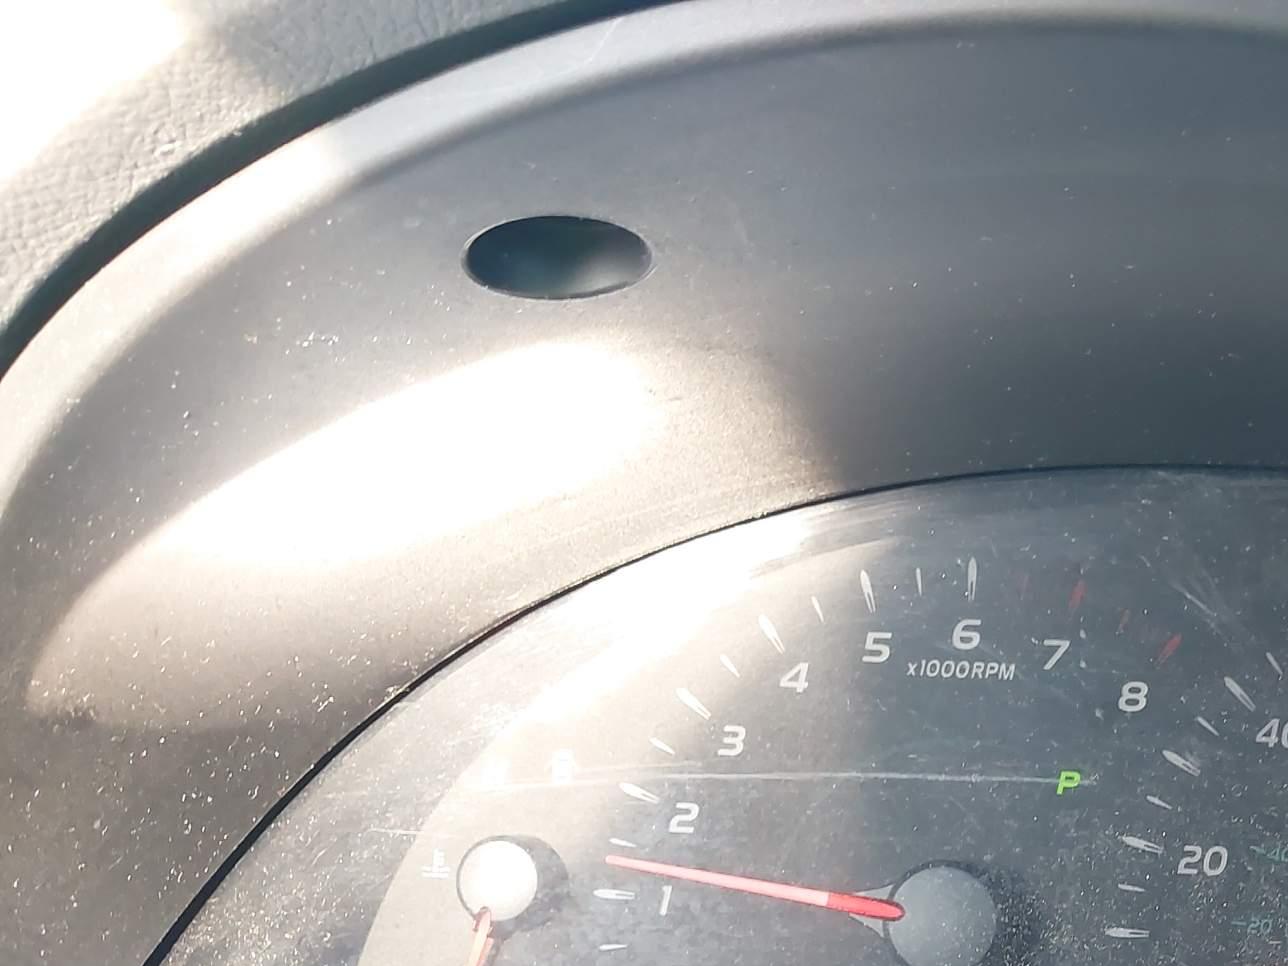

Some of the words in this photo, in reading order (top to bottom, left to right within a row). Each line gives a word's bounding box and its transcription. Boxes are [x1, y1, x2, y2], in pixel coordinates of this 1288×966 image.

[863, 632, 892, 663] 5
[954, 619, 981, 650] 6
[1043, 640, 1070, 670] 7
[780, 663, 810, 692] 4
[906, 660, 1016, 682] x1000RPM
[1118, 682, 1149, 712] 8
[718, 725, 747, 756] 3
[1056, 771, 1081, 794] P
[669, 802, 700, 833] 2
[1177, 845, 1228, 876] 20
[658, 884, 674, 915] 1
